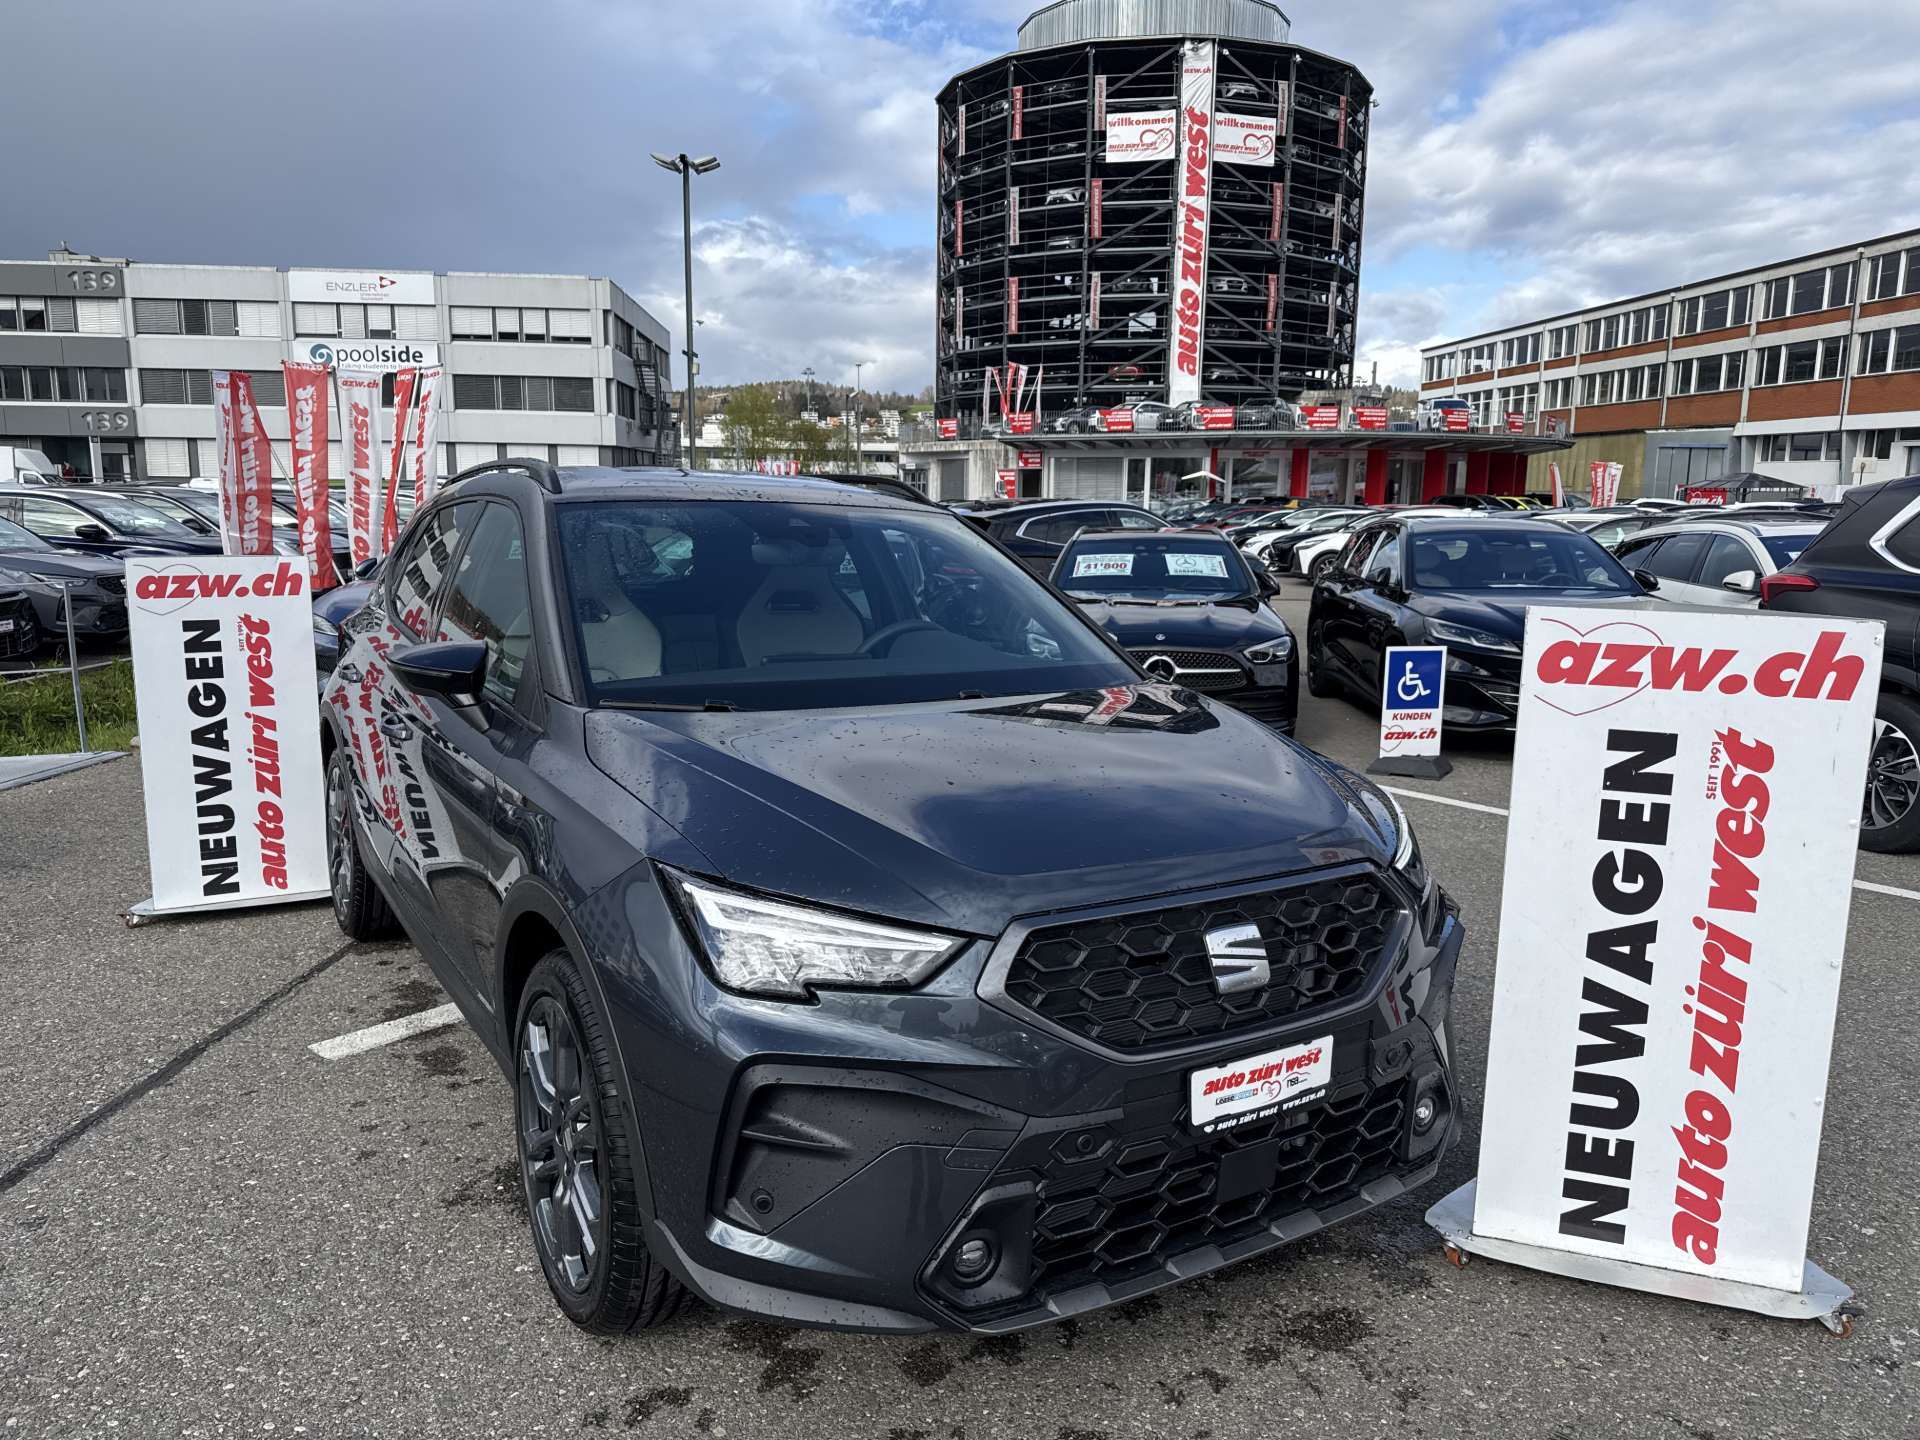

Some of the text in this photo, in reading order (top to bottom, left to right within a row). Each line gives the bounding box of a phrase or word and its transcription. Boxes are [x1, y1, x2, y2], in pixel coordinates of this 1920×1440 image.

[1108, 117, 1174, 128] willkommen
[1215, 118, 1274, 131] willkommen
[1175, 105, 1208, 376] auto züri west
[67, 271, 116, 291] 139
[326, 281, 378, 292] ENZLER
[336, 344, 423, 368] poolside
[342, 378, 379, 390] azw.ch
[82, 411, 129, 431] 139
[352, 401, 370, 470] west
[350, 471, 371, 536] züri
[135, 562, 303, 599] azw.ch
[1537, 631, 1864, 701] azw.ch
[1384, 728, 1437, 740] azw.ch
[1392, 712, 1432, 720] KUNDEN
[182, 618, 240, 896] NEUWAGEN
[237, 612, 289, 891] auto züri west
[1706, 740, 1724, 800] SEIT 1991
[1558, 728, 1679, 1245] NEUWAGEN
[1670, 727, 1775, 1266] auto züri west
[1203, 1071, 1246, 1096] auto
[1246, 1057, 1285, 1085] züri
[1285, 1047, 1322, 1073] west
[1217, 1118, 1237, 1130] auto
[1260, 1106, 1278, 1118] west
